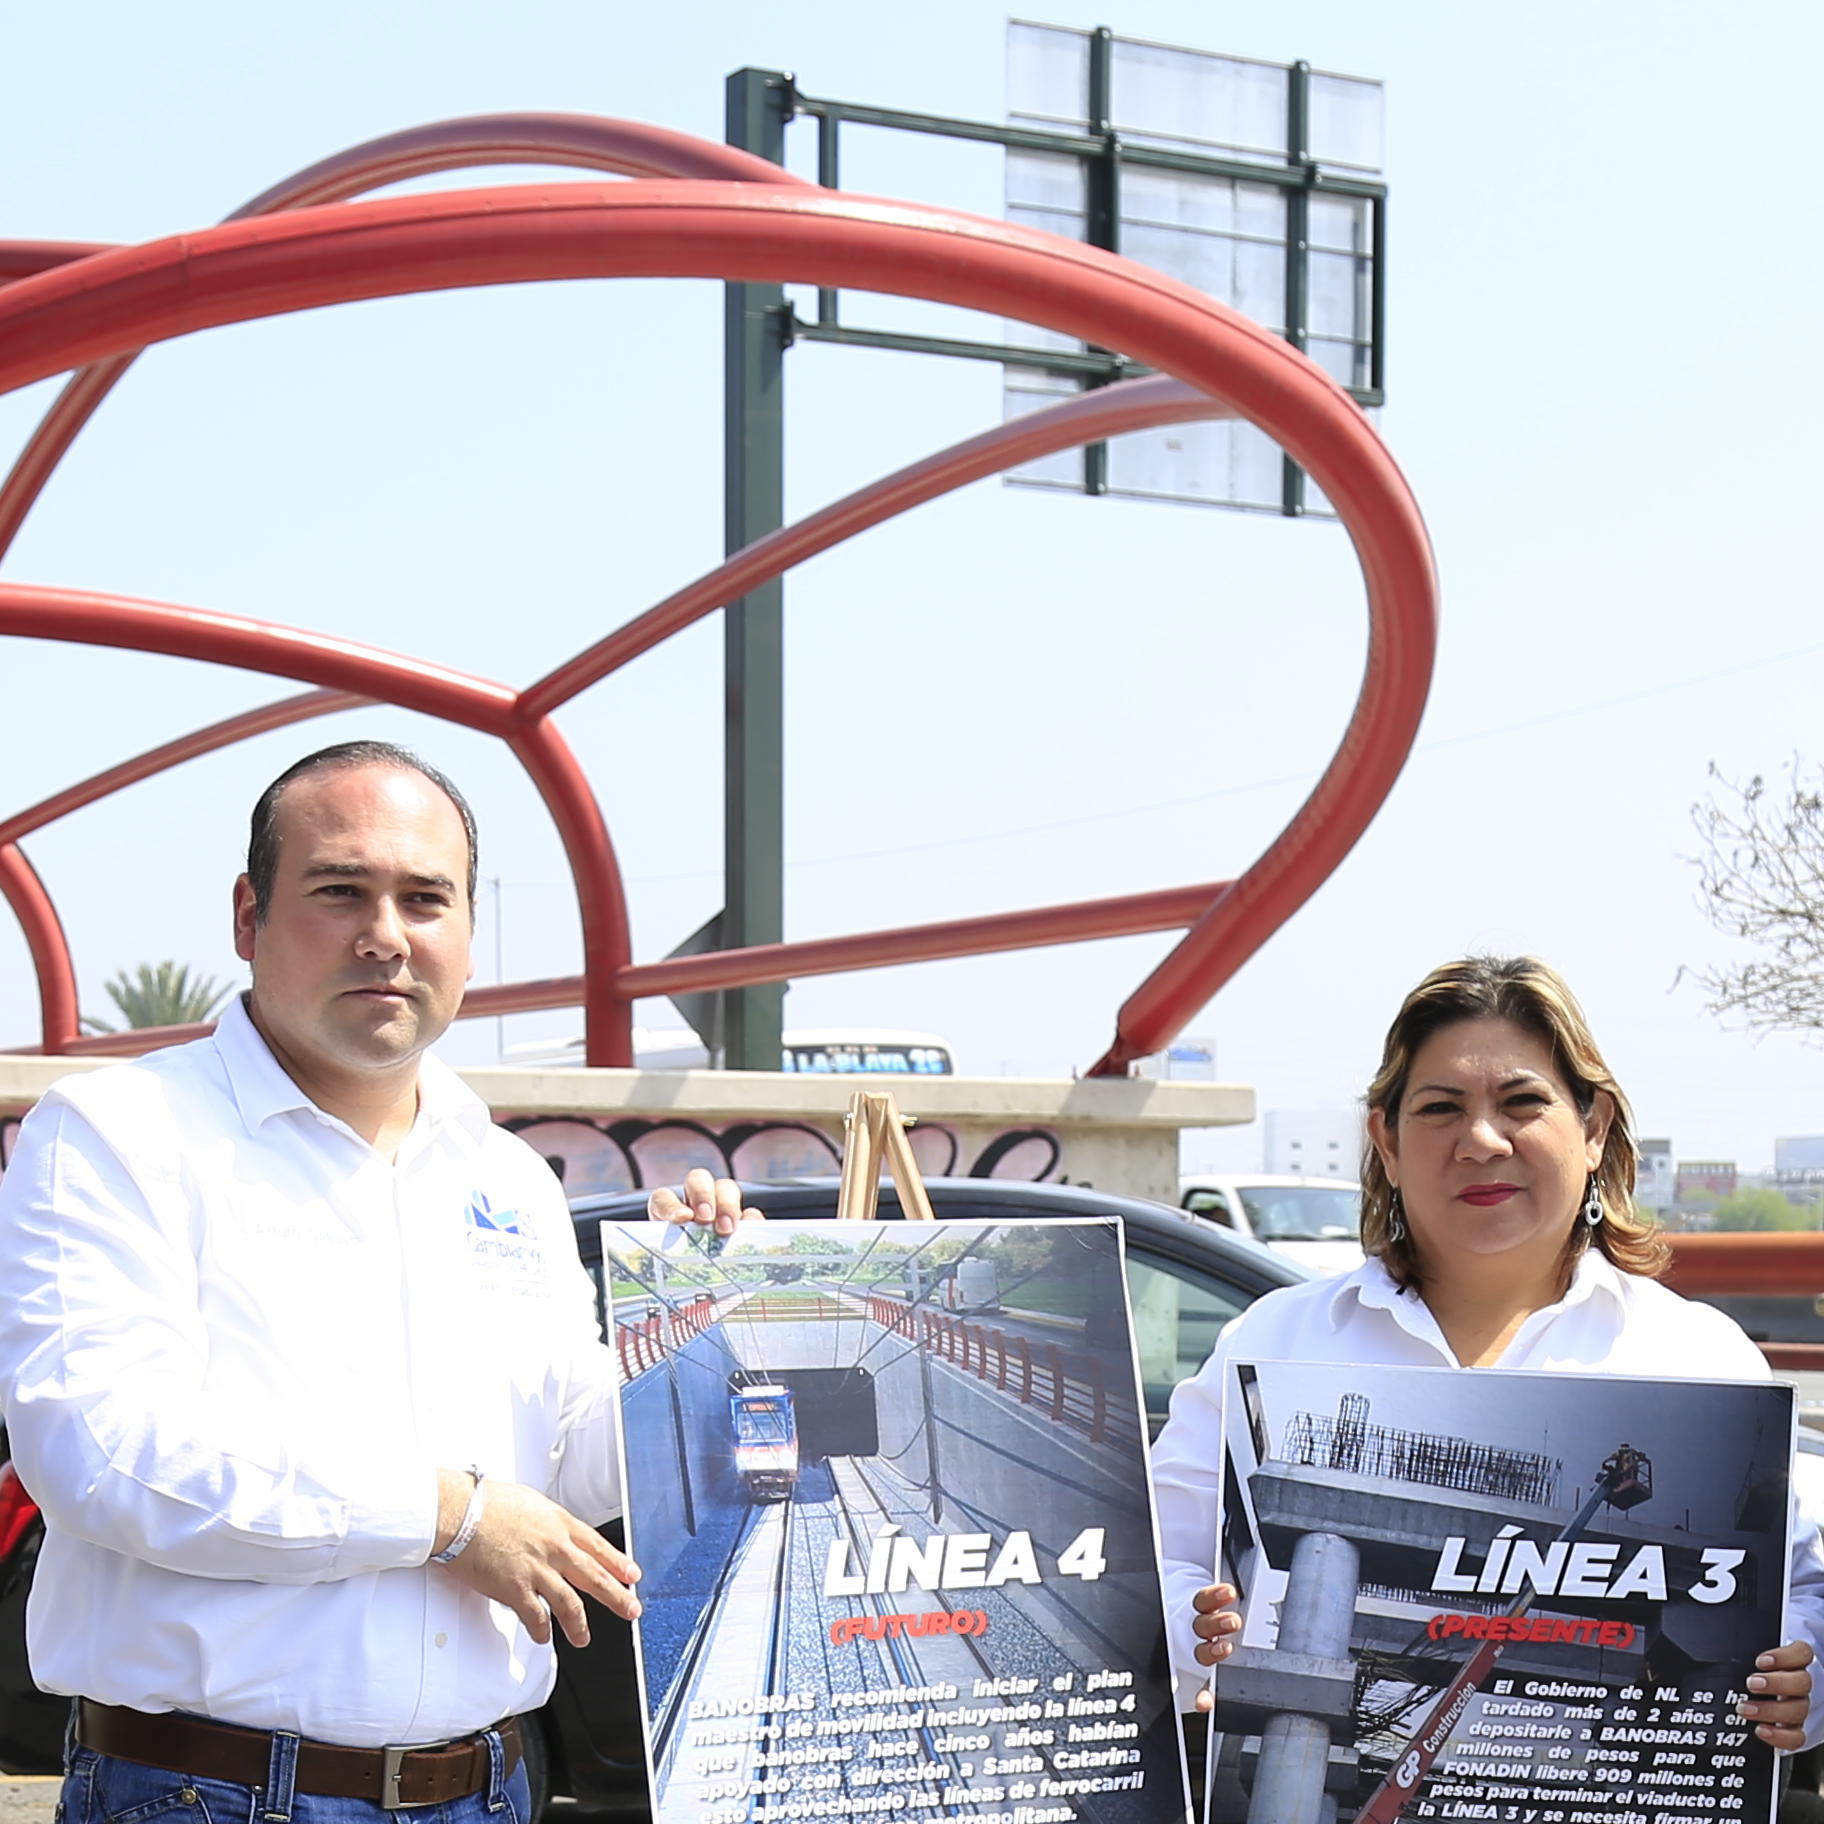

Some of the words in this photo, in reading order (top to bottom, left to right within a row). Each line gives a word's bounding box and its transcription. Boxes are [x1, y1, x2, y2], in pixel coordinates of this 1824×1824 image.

[823, 1523, 1043, 1598] LÍNEA
[1056, 1527, 1107, 1581] 4
[1429, 1523, 1666, 1601] LÍNEA
[1687, 1547, 1747, 1605] 3
[830, 1609, 988, 1646] (FUTURO)
[1427, 1614, 1635, 1649] (PRESENTE)
[829, 1681, 958, 1709] recomienda
[972, 1675, 1040, 1698] iniciar
[1086, 1668, 1133, 1693] plan
[1523, 1680, 1609, 1700] Gobierno
[815, 1708, 925, 1737] movilidad
[925, 1700, 1043, 1728] incluyendo
[1066, 1696, 1118, 1717] línea
[1480, 1699, 1557, 1719] tardado
[1562, 1704, 1605, 1721] más
[1669, 1708, 1716, 1726] años
[748, 1743, 854, 1769] banobras
[866, 1739, 920, 1759] hace
[933, 1732, 991, 1753] cinco
[1003, 1726, 1055, 1748] años
[1067, 1719, 1139, 1743] habían
[1466, 1719, 1573, 1742] depositarle
[1599, 1725, 1708, 1747] BANOBRAS
[1715, 1731, 1749, 1748] 147
[799, 1772, 842, 1791] con
[850, 1760, 951, 1787] dirección
[982, 1754, 1044, 1776] Santa
[1052, 1746, 1140, 1770] Catarina
[1453, 1739, 1535, 1759] millones
[1583, 1748, 1641, 1765] pesos
[1651, 1751, 1697, 1767] para
[1710, 1754, 1747, 1770] que
[1441, 1760, 1533, 1780] FONADIN
[1533, 1764, 1590, 1783] libere
[1593, 1767, 1634, 1784] 909
[1636, 1769, 1717, 1788] millones
[750, 1790, 906, 1824] aprovechando
[908, 1788, 940, 1809] las
[942, 1784, 1005, 1806] líneas
[1039, 1771, 1144, 1798] ferrocarril
[1416, 1800, 1437, 1818] la
[1440, 1799, 1499, 1821] LÍNEA
[1541, 1809, 1565, 1823] se
[1428, 1783, 1486, 1800] pesos
[1484, 1785, 1530, 1802] para
[1531, 1785, 1615, 1804] terminar
[1636, 1790, 1717, 1809] viaducto
